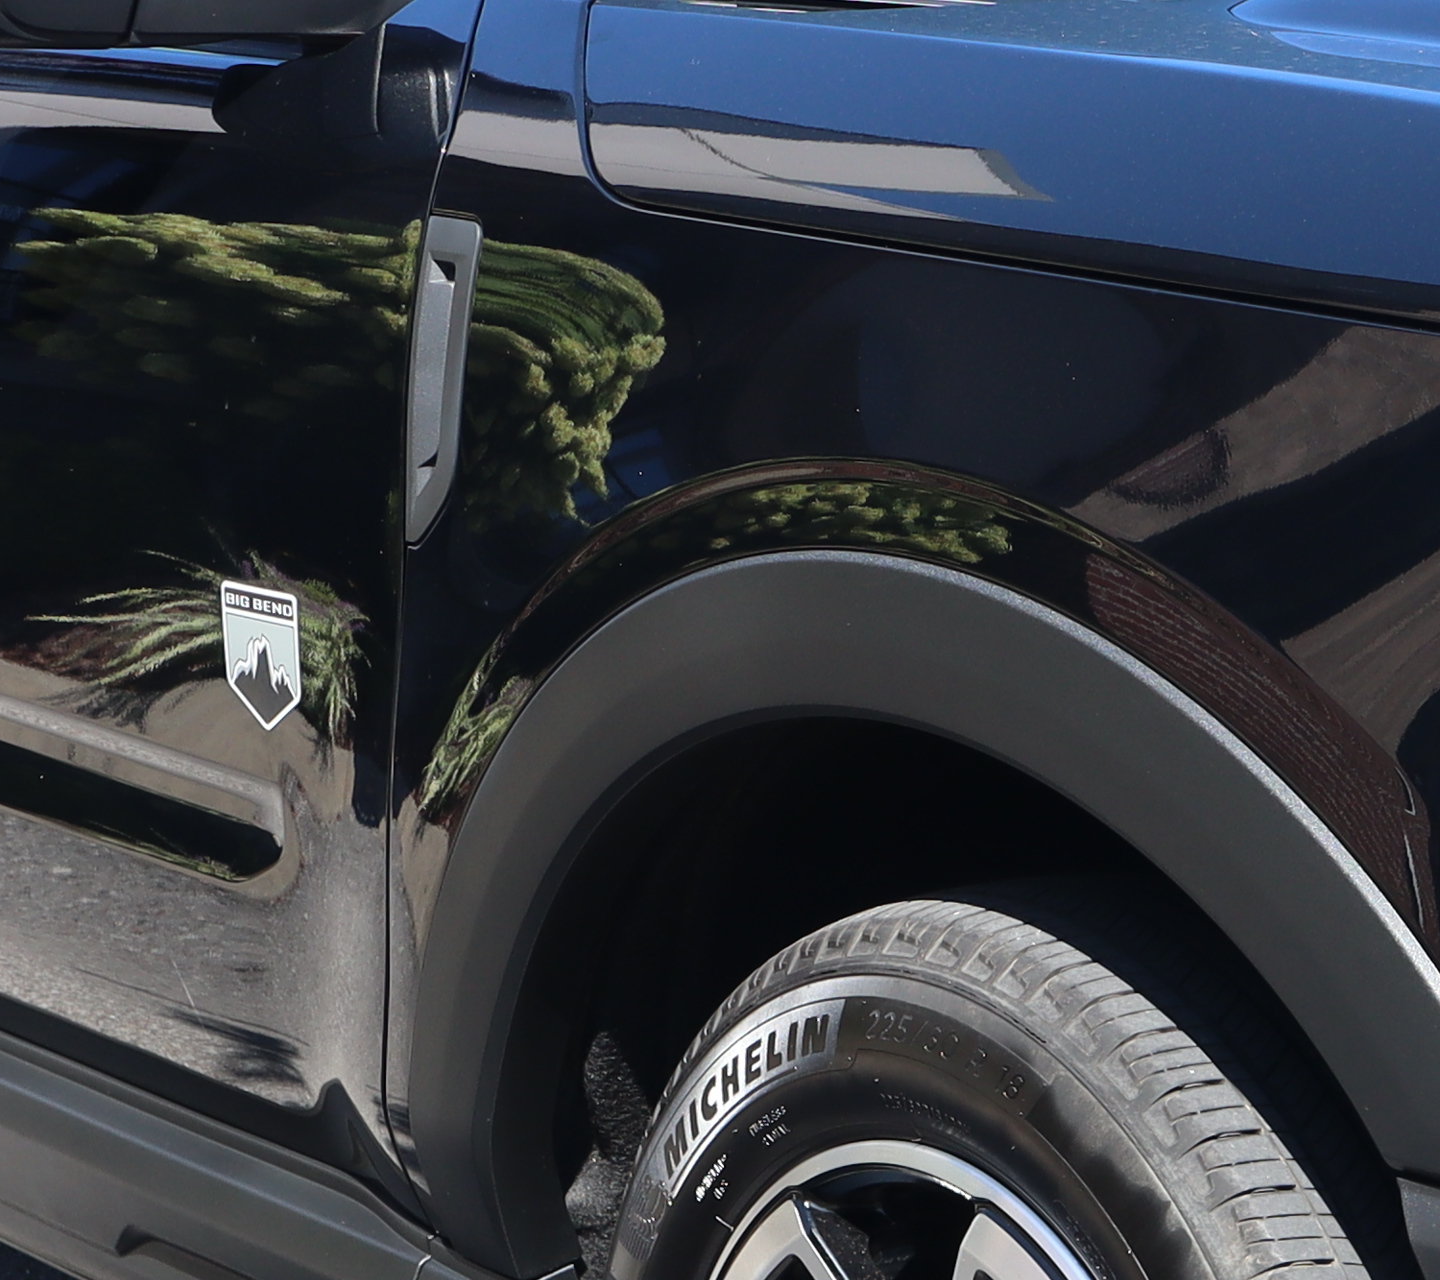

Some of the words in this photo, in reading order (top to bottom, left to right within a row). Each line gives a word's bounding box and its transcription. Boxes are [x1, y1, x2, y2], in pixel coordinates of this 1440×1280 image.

[226, 593, 250, 608] BIG
[253, 598, 293, 617] BEND
[662, 1013, 832, 1180] MICHELIN
